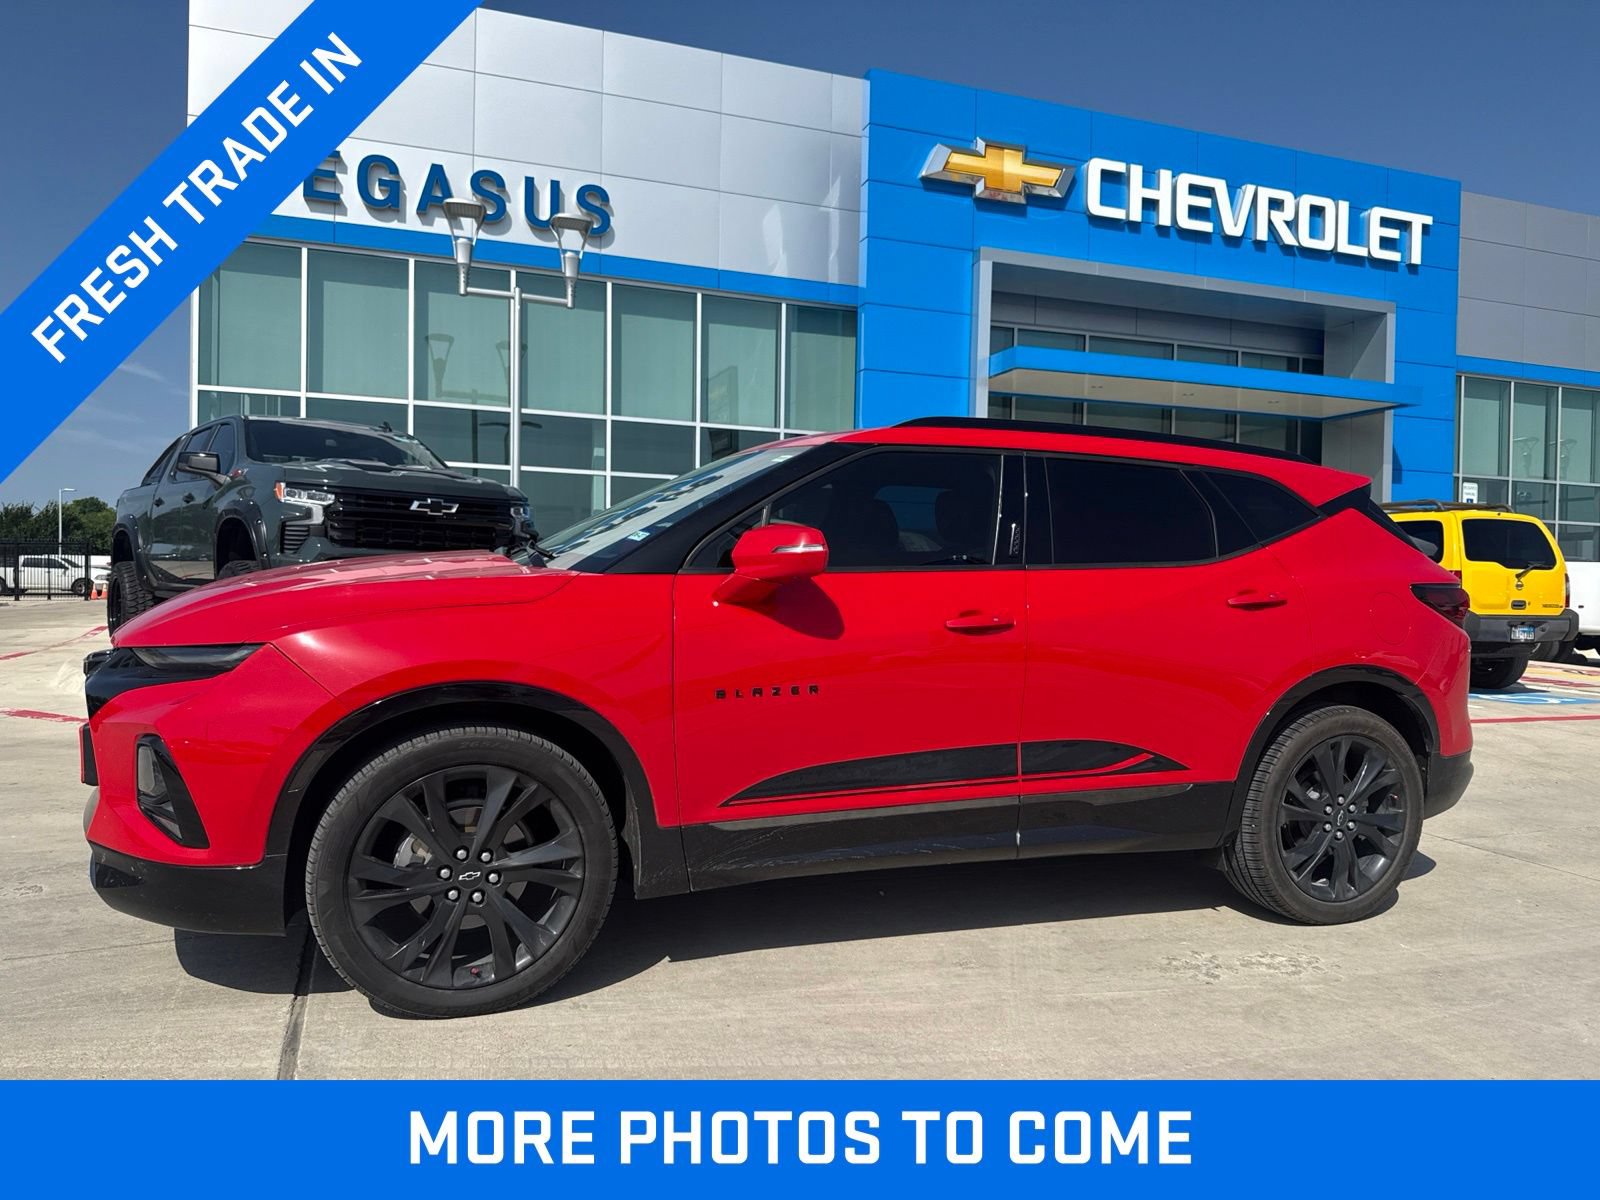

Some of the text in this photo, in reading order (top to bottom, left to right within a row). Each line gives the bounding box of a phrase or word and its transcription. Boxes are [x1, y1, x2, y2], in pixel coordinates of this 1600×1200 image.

[303, 150, 611, 236] EGASUS
[1086, 158, 1433, 265] CHEVROLET
[714, 684, 820, 700] BLAZER
